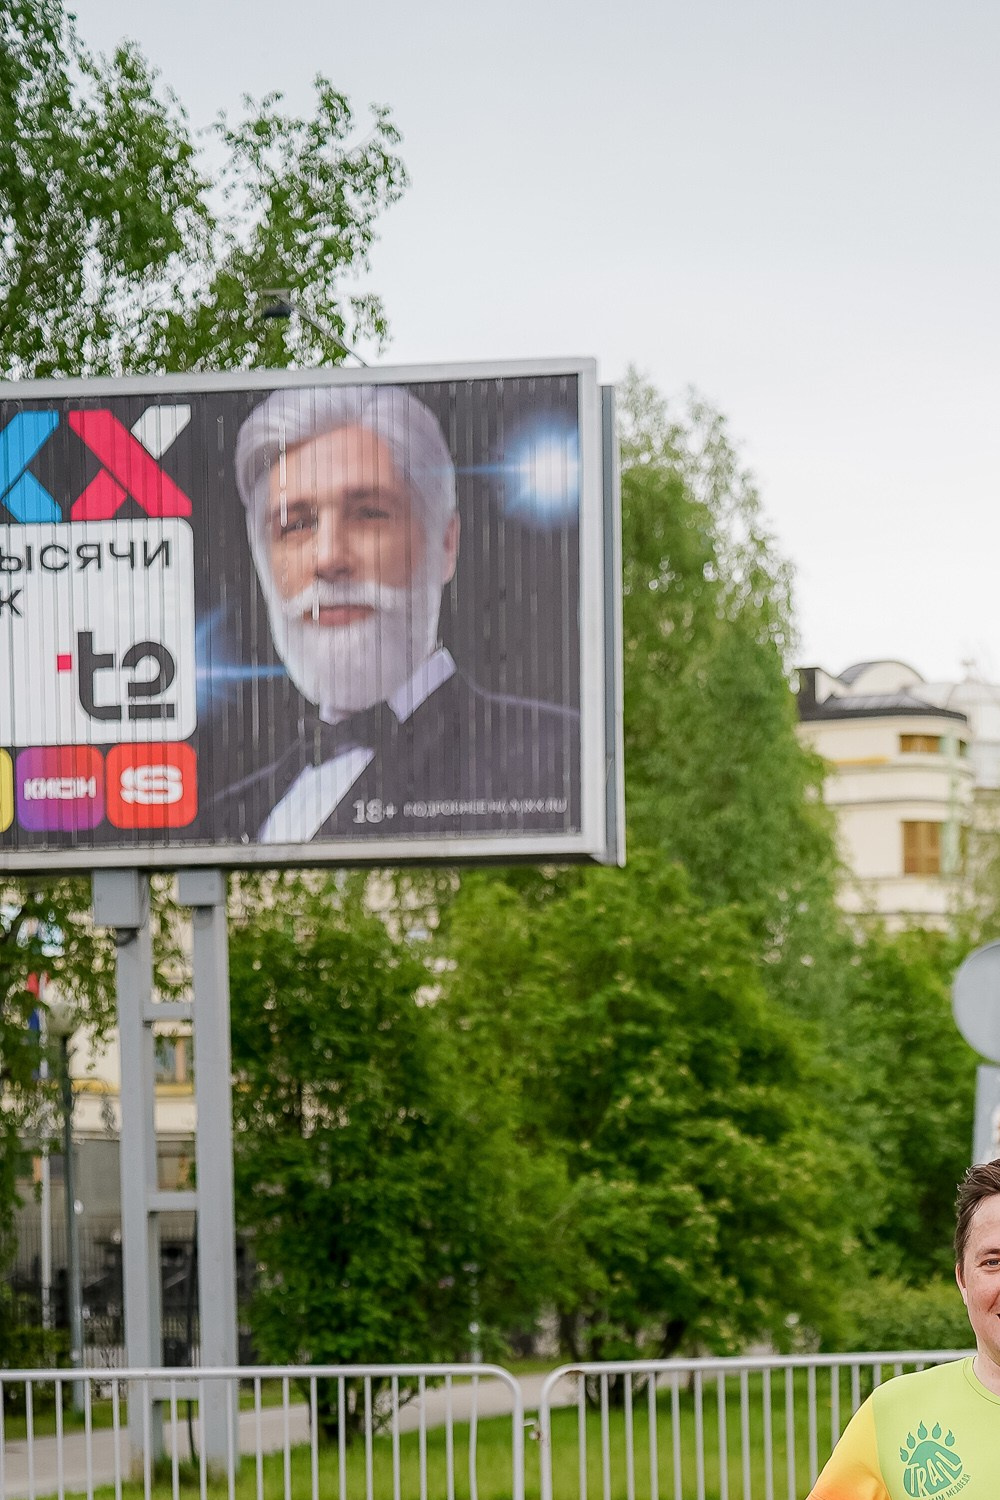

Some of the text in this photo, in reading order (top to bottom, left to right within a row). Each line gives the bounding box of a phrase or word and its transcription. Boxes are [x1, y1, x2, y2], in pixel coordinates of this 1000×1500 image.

[352, 799, 398, 824] 18+
[906, 1451, 962, 1497] TRAIL
[945, 1473, 972, 1499] МЕДВЕДЯ
